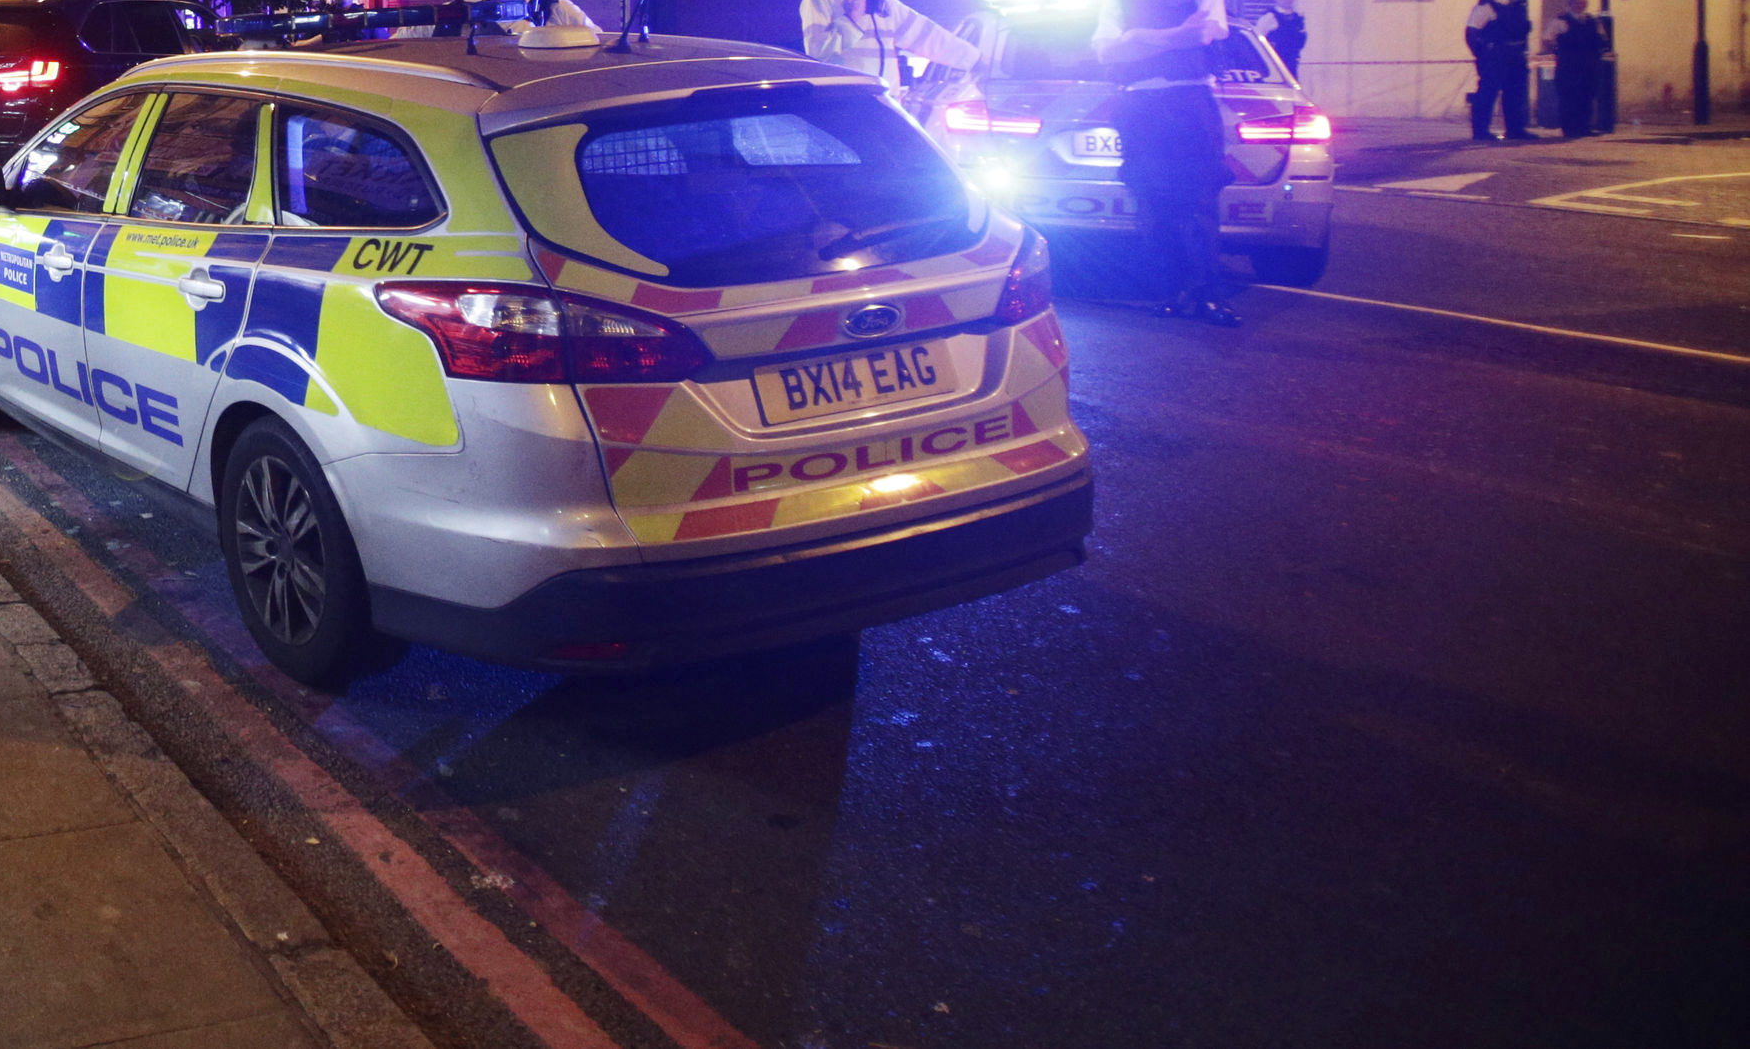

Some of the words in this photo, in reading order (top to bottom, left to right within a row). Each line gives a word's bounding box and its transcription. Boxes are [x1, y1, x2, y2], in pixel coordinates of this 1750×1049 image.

[125, 230, 200, 250] www.met.police.uk
[0, 250, 34, 270] METROPOLITAN
[351, 237, 435, 278] CWT
[2, 267, 29, 286] POLICE
[779, 357, 863, 411] BX14
[866, 345, 938, 395] EAG
[733, 415, 1012, 494] POLICE
